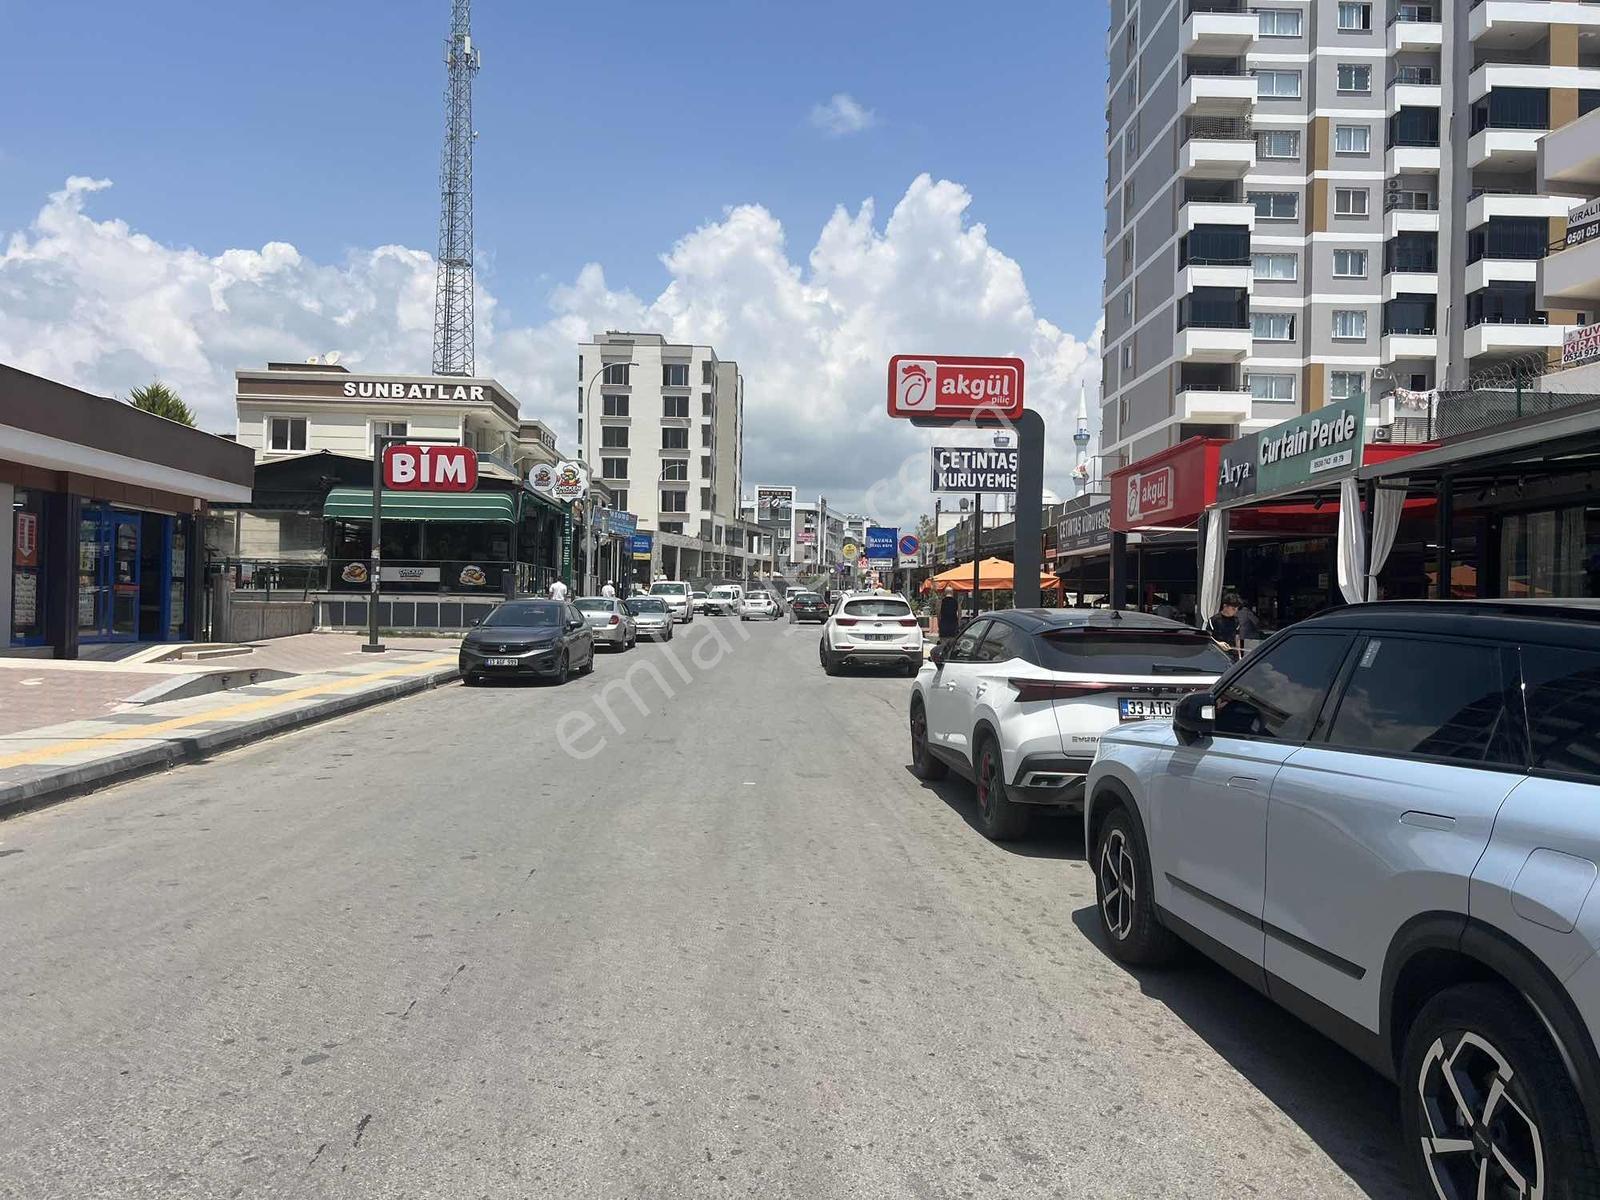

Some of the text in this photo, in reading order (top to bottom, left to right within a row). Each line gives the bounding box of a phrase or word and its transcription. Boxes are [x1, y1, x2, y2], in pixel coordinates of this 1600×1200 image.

[1569, 203, 1600, 224] KİRALI
[1567, 223, 1599, 244] 0501 051
[1564, 346, 1598, 362] 0534 972
[343, 382, 485, 401] SUNBATLAR
[942, 373, 1010, 400] akgül
[991, 396, 1010, 406] piliç
[1218, 409, 1355, 488] Arya Curtain Perde
[392, 446, 467, 484] BİM
[1141, 476, 1166, 504] akgül
[1129, 701, 1172, 715] 33 ATG
